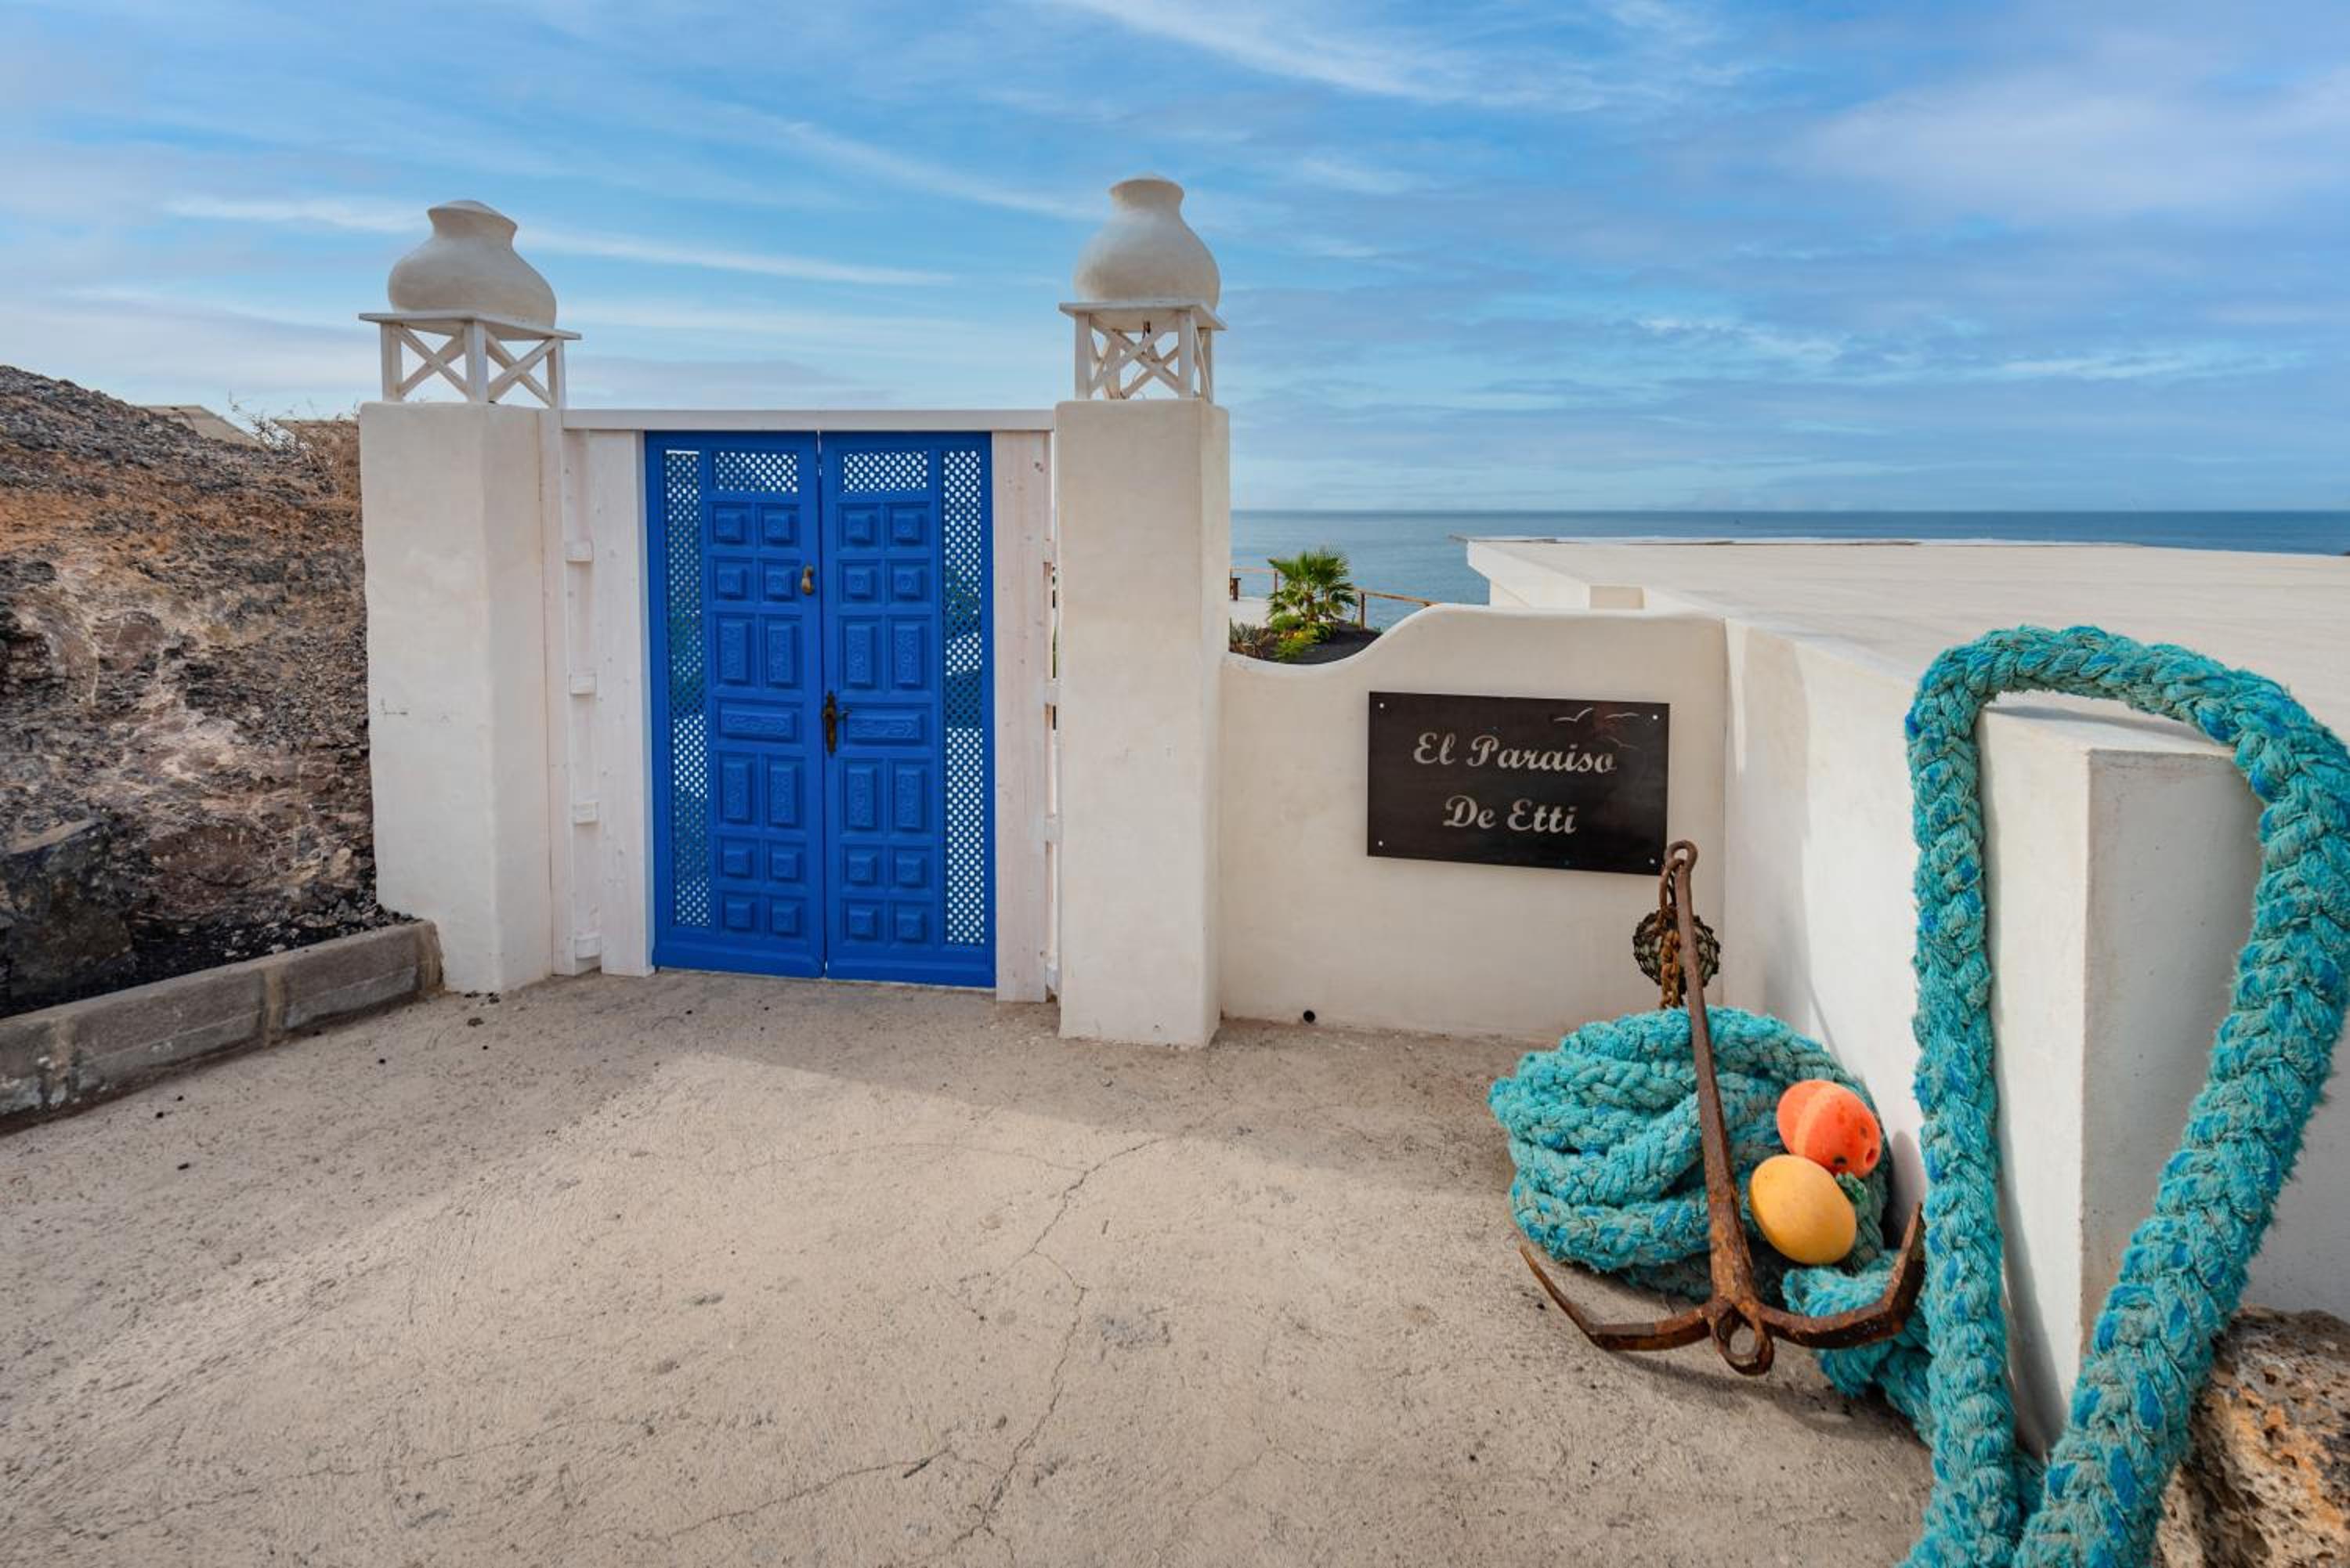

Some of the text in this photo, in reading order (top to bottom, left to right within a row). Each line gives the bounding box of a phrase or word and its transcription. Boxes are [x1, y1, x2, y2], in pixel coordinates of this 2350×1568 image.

[1413, 733, 1617, 774] El Paraiso
[1443, 795, 1578, 834] De Etti
